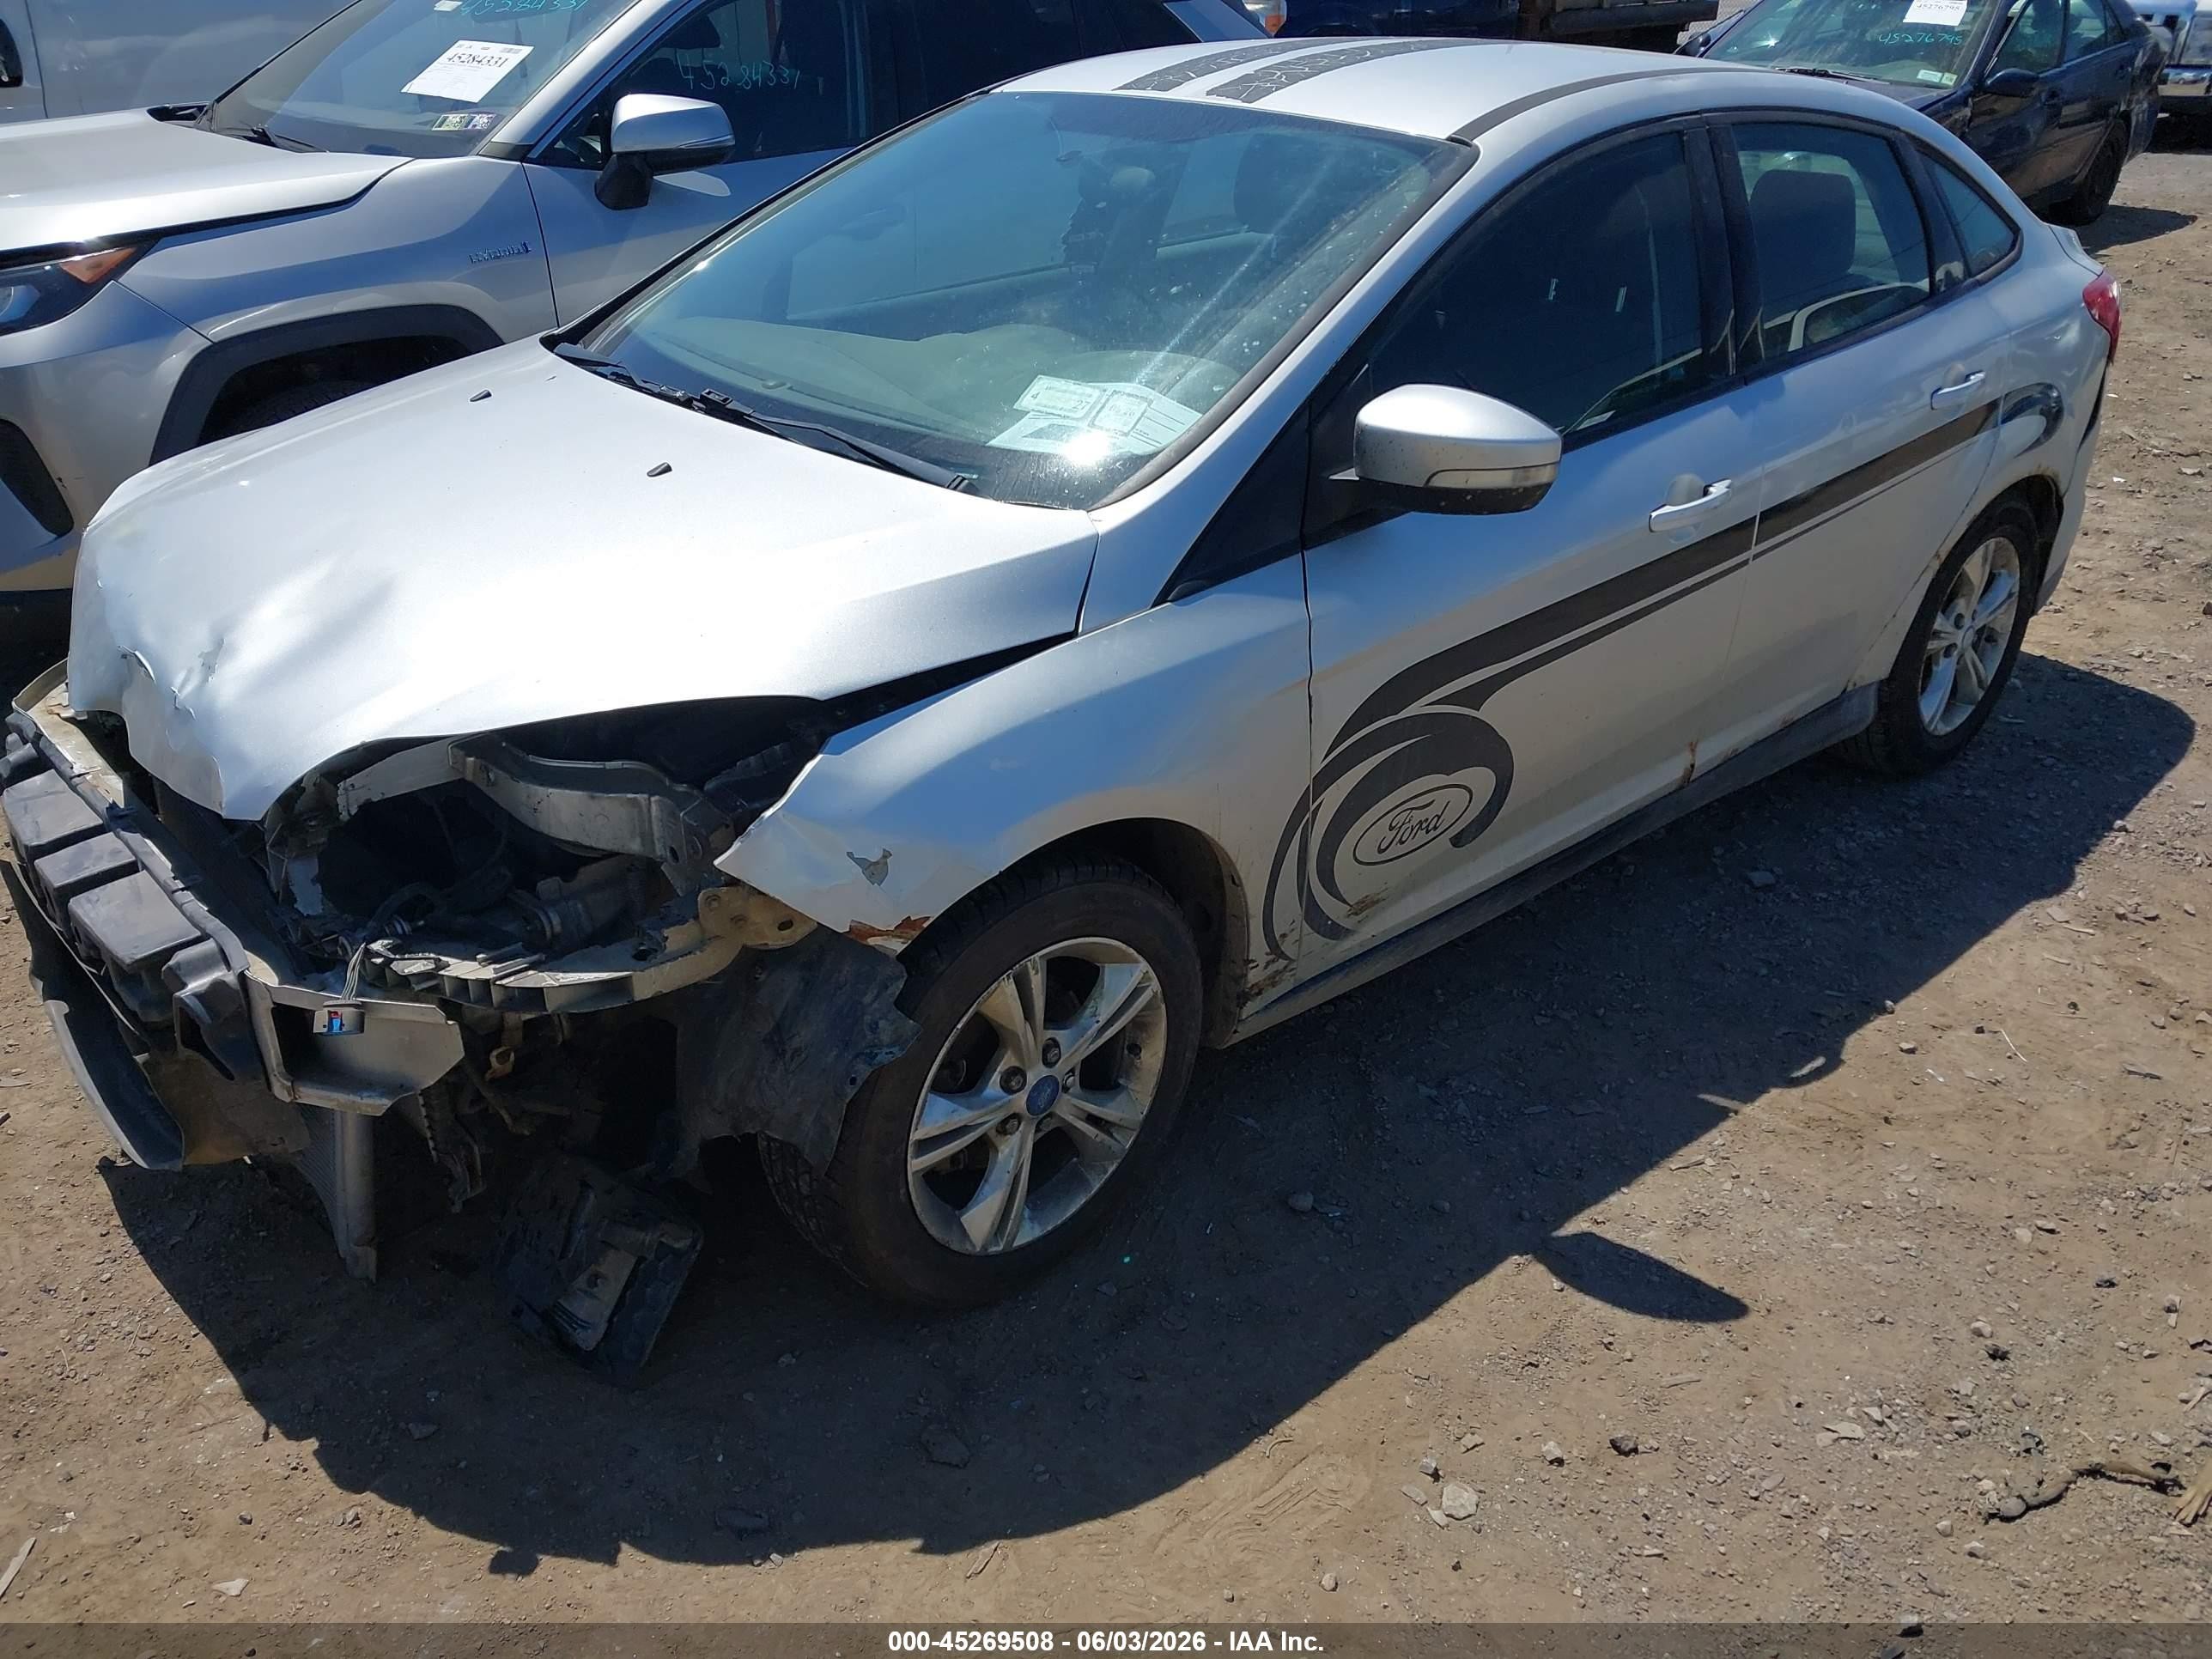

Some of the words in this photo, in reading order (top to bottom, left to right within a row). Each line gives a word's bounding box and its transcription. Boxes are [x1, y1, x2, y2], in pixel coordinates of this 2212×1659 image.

[1879, 33, 1962, 45] 45276795
[447, 52, 508, 67] 45284331
[676, 49, 800, 89] 45284331
[1377, 799, 1450, 854] Ford
